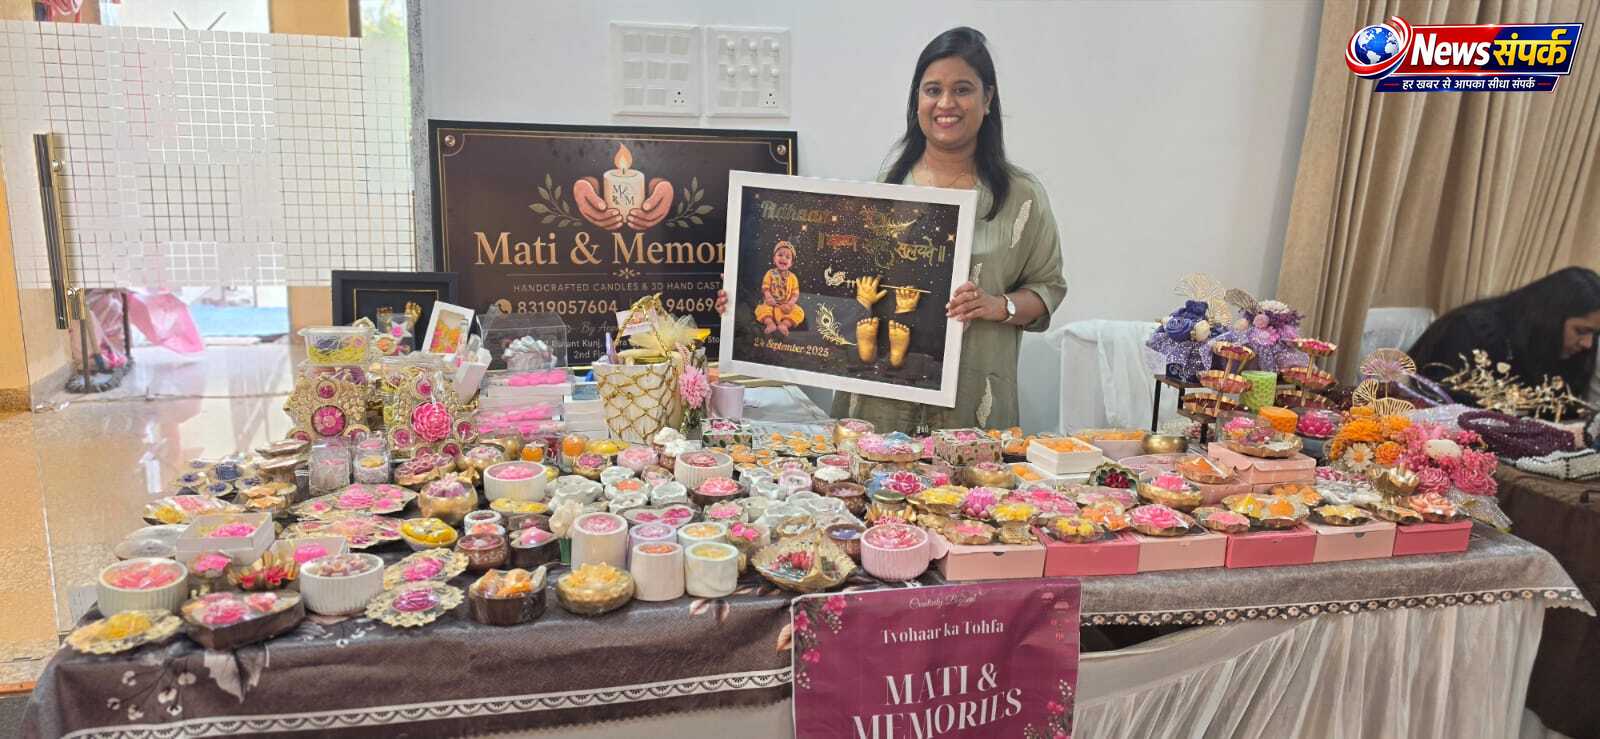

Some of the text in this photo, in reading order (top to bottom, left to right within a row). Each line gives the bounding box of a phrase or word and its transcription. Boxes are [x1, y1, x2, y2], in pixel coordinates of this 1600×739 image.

[474, 231, 559, 265] Mati
[570, 231, 603, 265] &
[513, 282, 590, 293] HANDCRAFTED
[592, 281, 638, 292] CANDLES
[641, 282, 649, 291] &
[666, 280, 694, 290] HAND
[517, 299, 617, 315] 8319057604
[767, 338, 805, 353] September
[943, 622, 960, 638] ka
[961, 618, 1004, 635] Tohfa
[882, 662, 998, 706] MATI &
[850, 686, 1022, 739] MEMORIES
